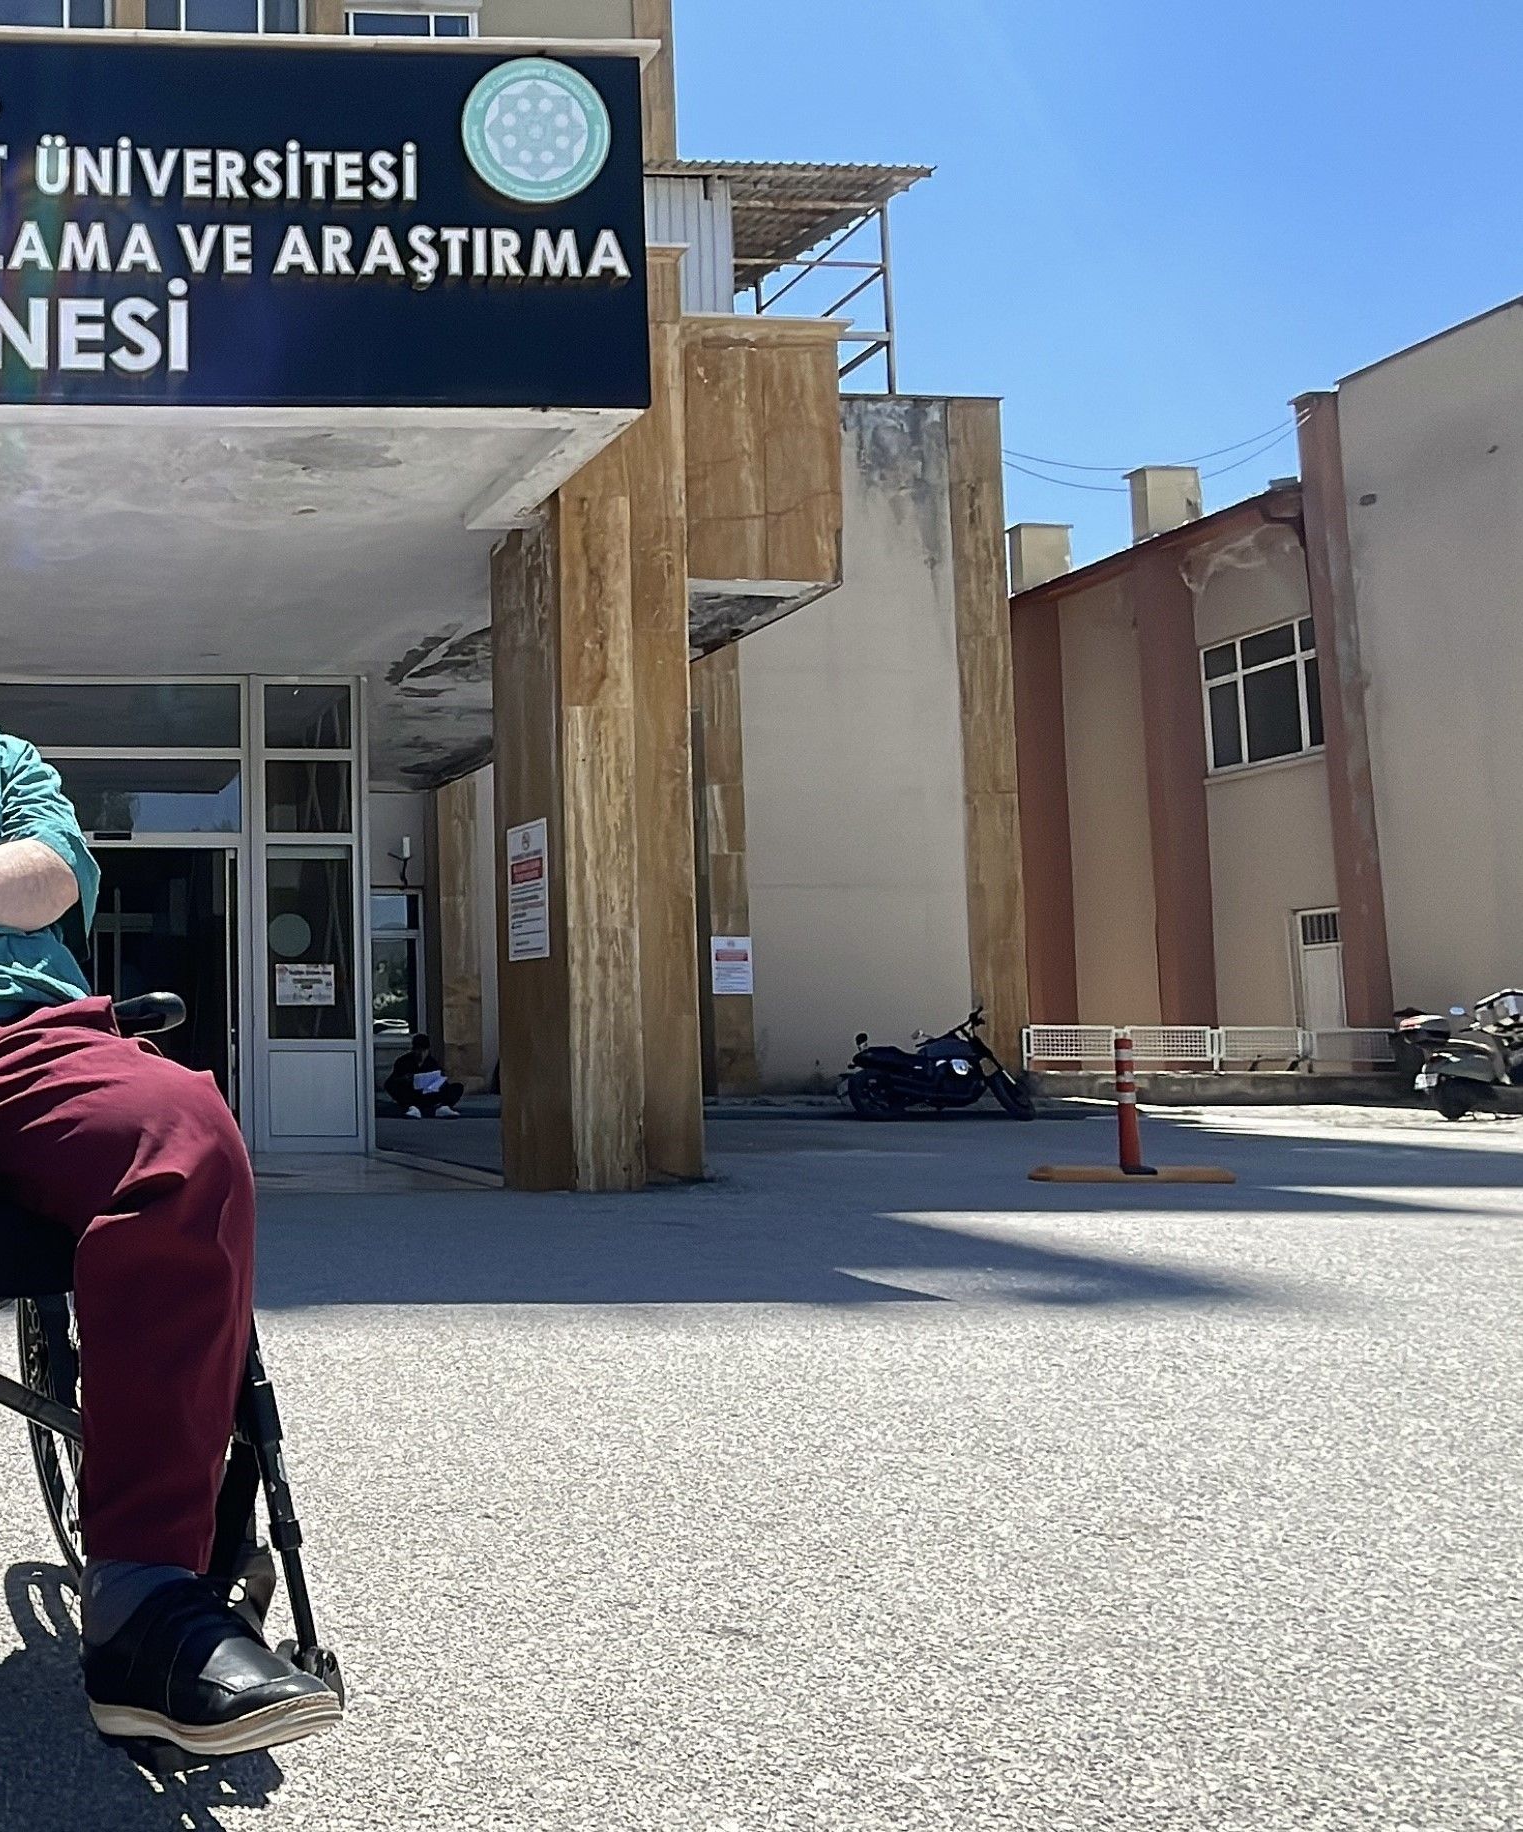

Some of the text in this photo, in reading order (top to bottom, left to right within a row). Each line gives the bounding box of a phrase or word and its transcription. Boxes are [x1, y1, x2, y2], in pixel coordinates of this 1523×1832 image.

[35, 134, 417, 201] ÜNİVERSİTESİ
[176, 224, 252, 274] VE
[272, 225, 631, 288] ARAŞTIRMA
